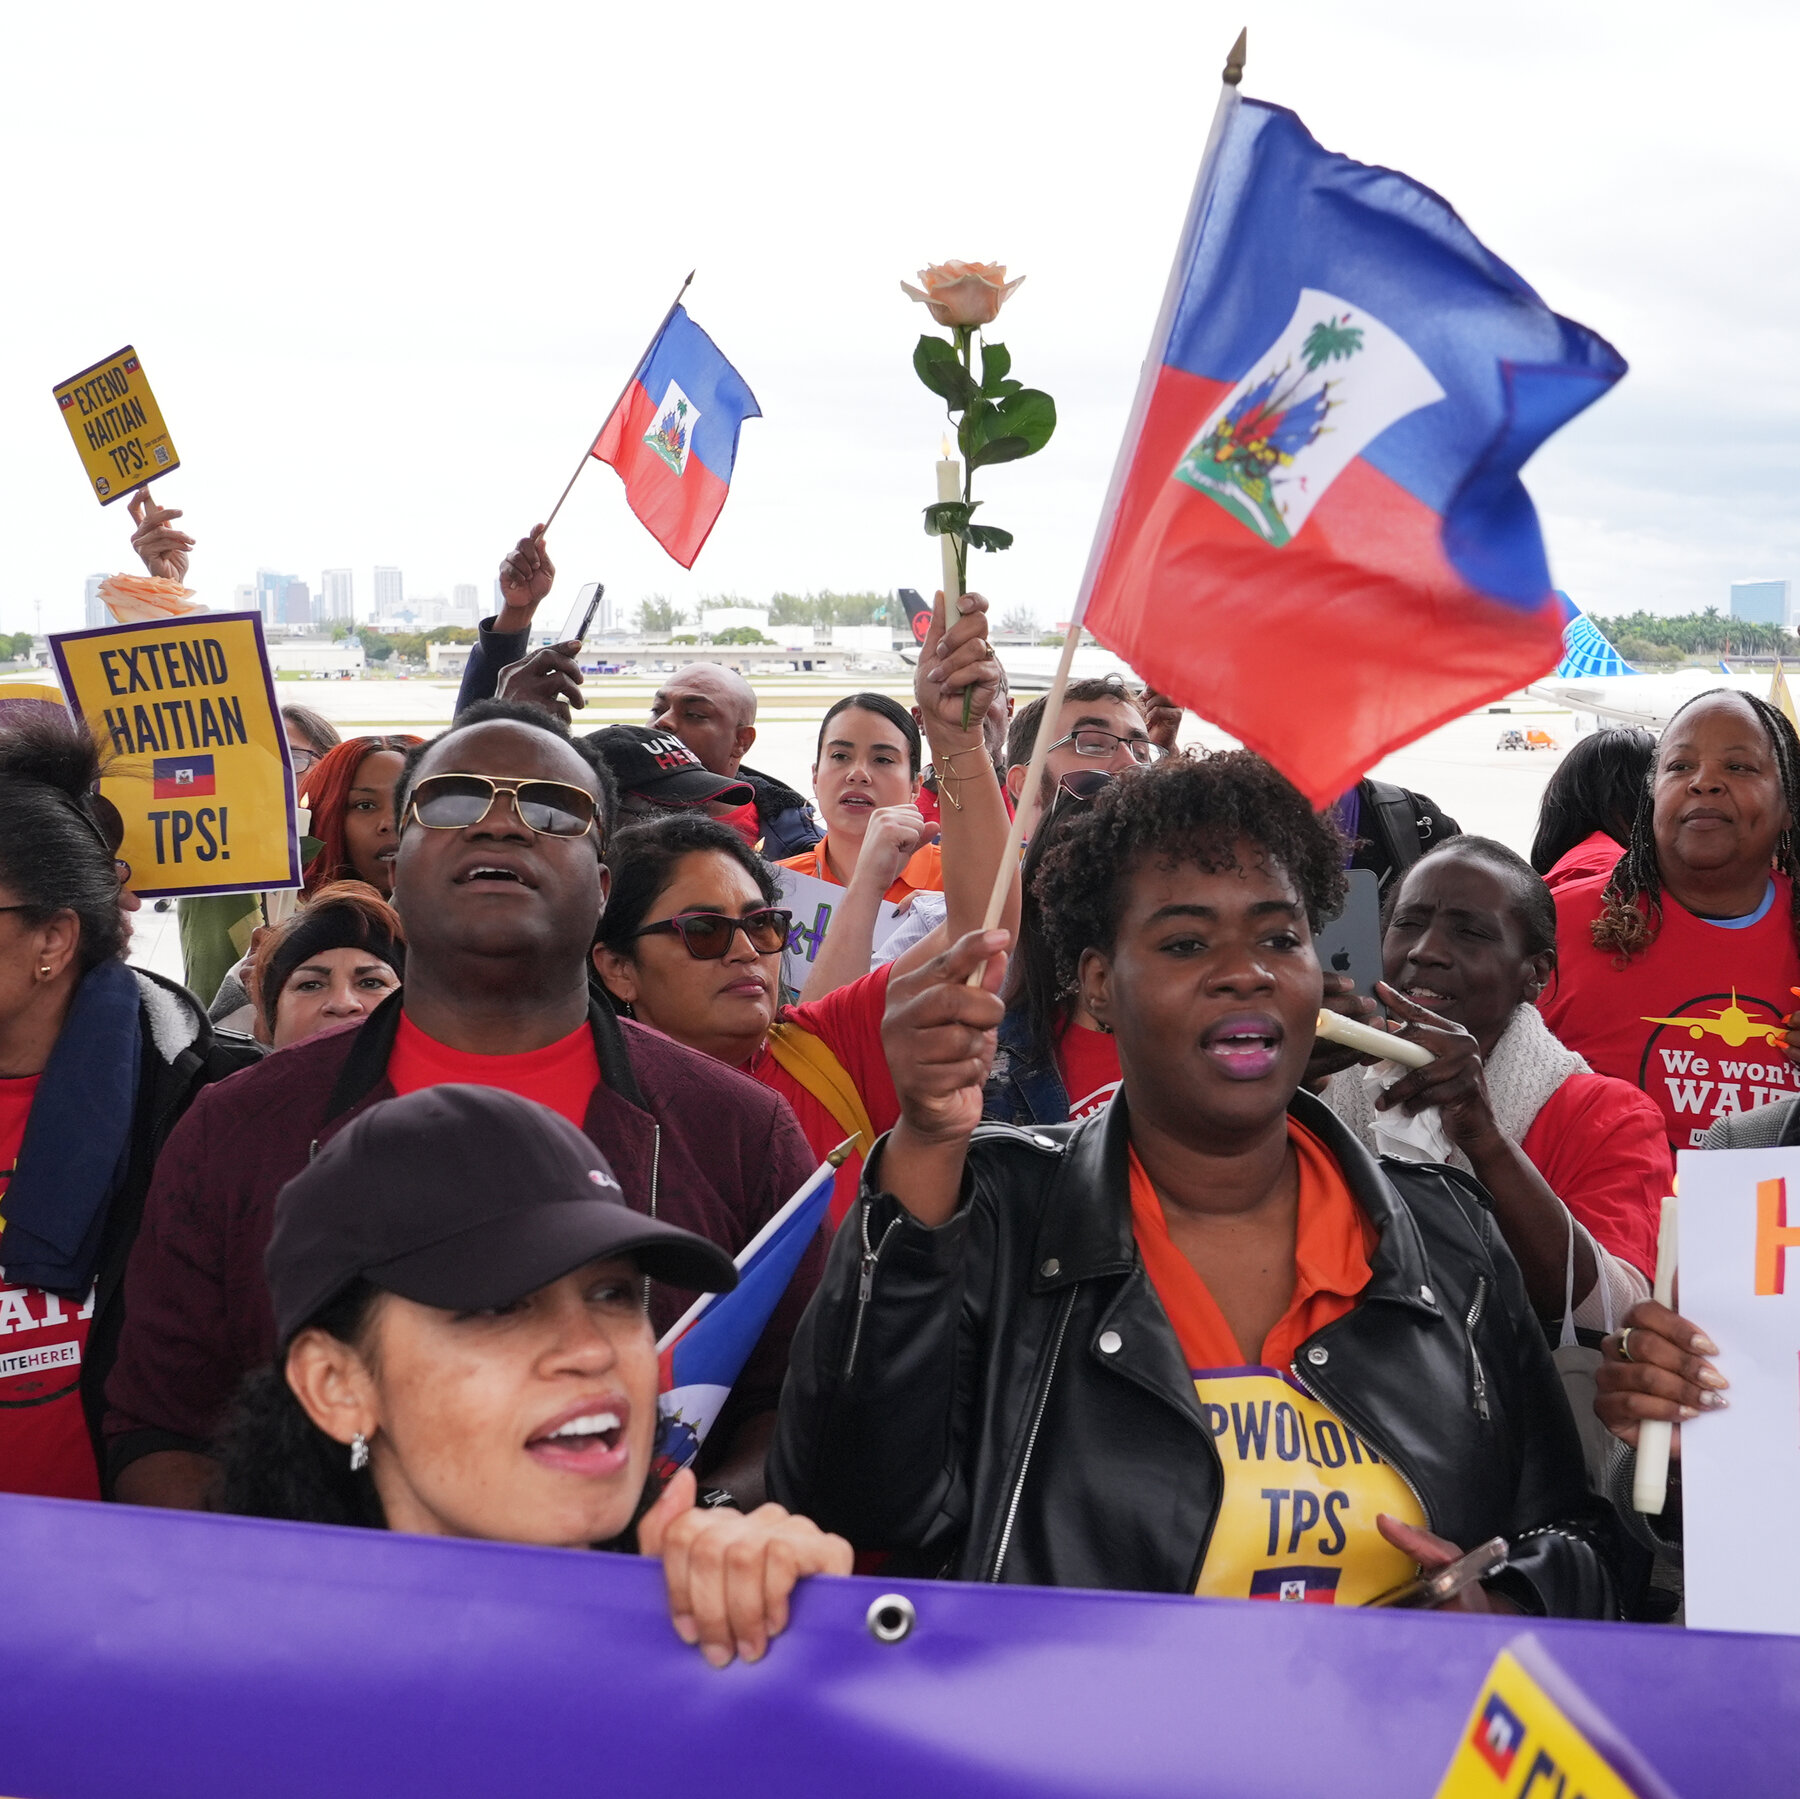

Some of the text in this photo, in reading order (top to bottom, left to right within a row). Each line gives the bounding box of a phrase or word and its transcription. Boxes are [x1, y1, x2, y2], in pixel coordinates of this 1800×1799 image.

[73, 367, 129, 416] EXTEND
[83, 396, 147, 451] HAITIAN
[108, 437, 149, 478] TPS!
[100, 639, 229, 696] EXTEND
[104, 696, 248, 754] HAITIAN
[148, 807, 230, 864] TPS!
[1659, 1049, 1709, 1076] We
[0, 1347, 74, 1372] ITEHERE!
[1261, 1488, 1350, 1556] TPS
